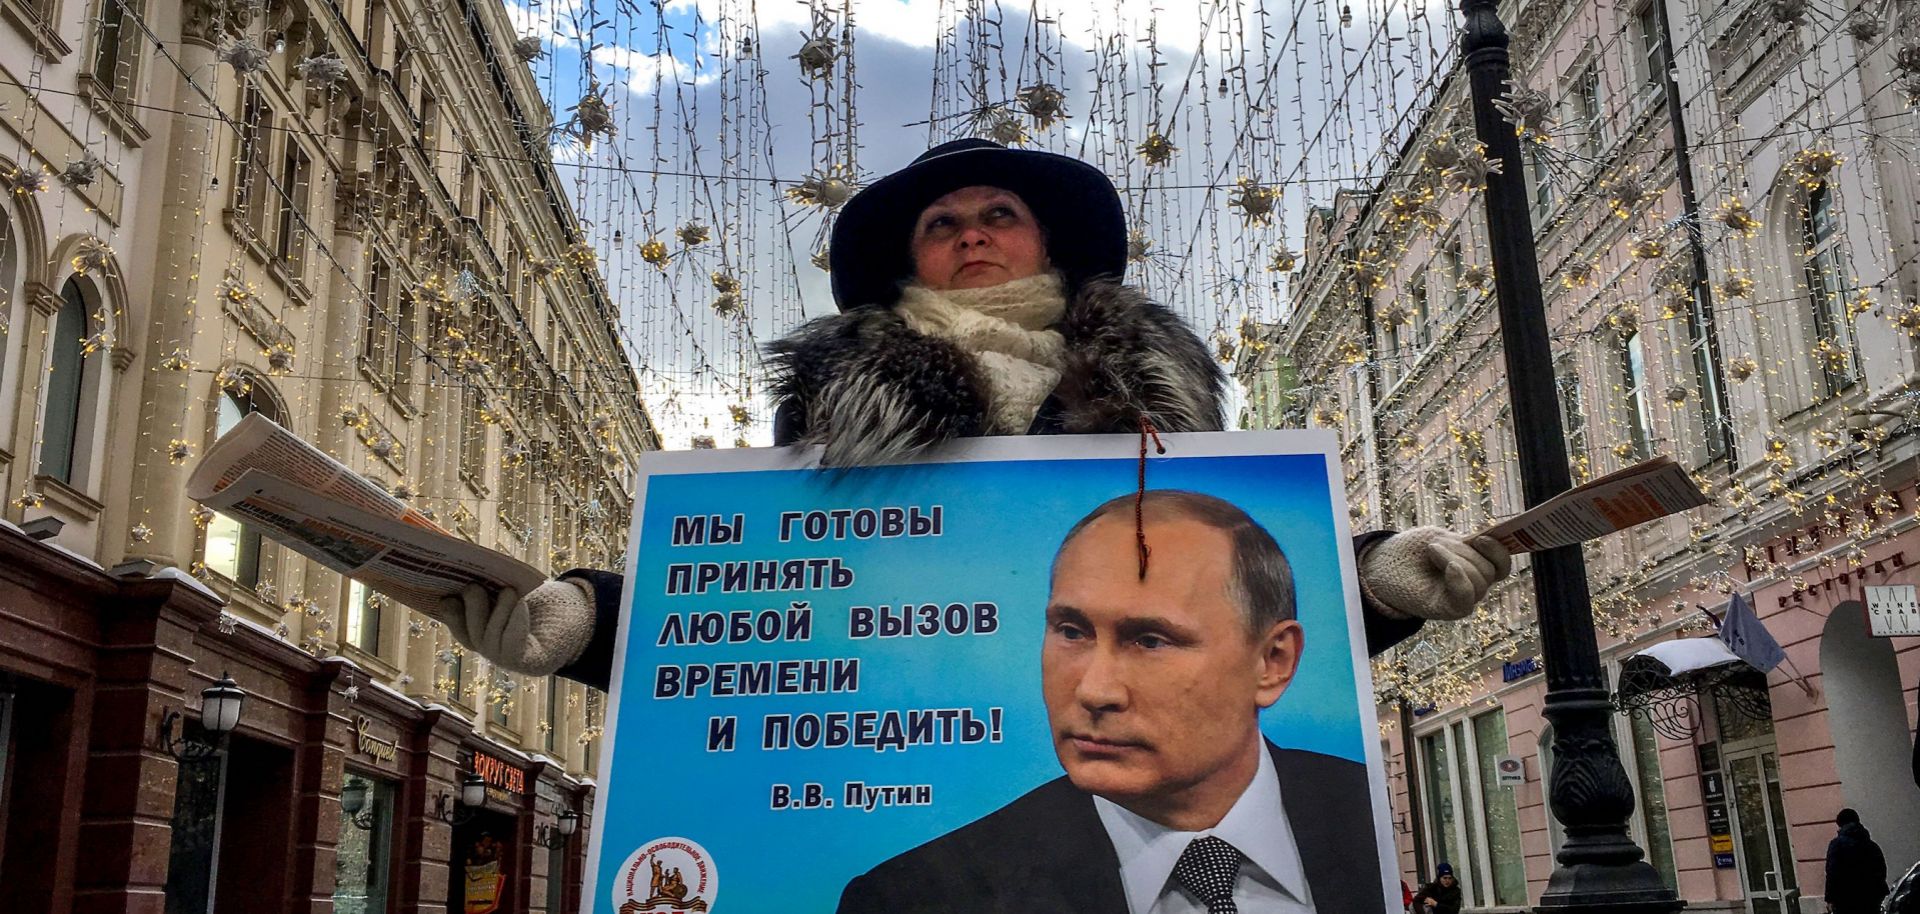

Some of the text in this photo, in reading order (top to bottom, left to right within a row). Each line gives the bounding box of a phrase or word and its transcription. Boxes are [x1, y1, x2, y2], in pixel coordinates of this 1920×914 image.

[671, 505, 943, 546] МЫ ГОТОВЫ
[665, 557, 855, 595] ПРИНЯТЬ
[656, 601, 999, 646] ЛЮБОЙ ВЫЗОВ
[1872, 601, 1915, 609] WINE
[653, 658, 860, 699] ВРЕМЕНИ
[706, 707, 1003, 753] И ПОБЕДИТЬ!
[770, 781, 932, 812] В.В. Путин
[625, 842, 702, 897] НАЦИОНАЛЬНО-ОСВОБОДИТЕЛЬНОЕ
